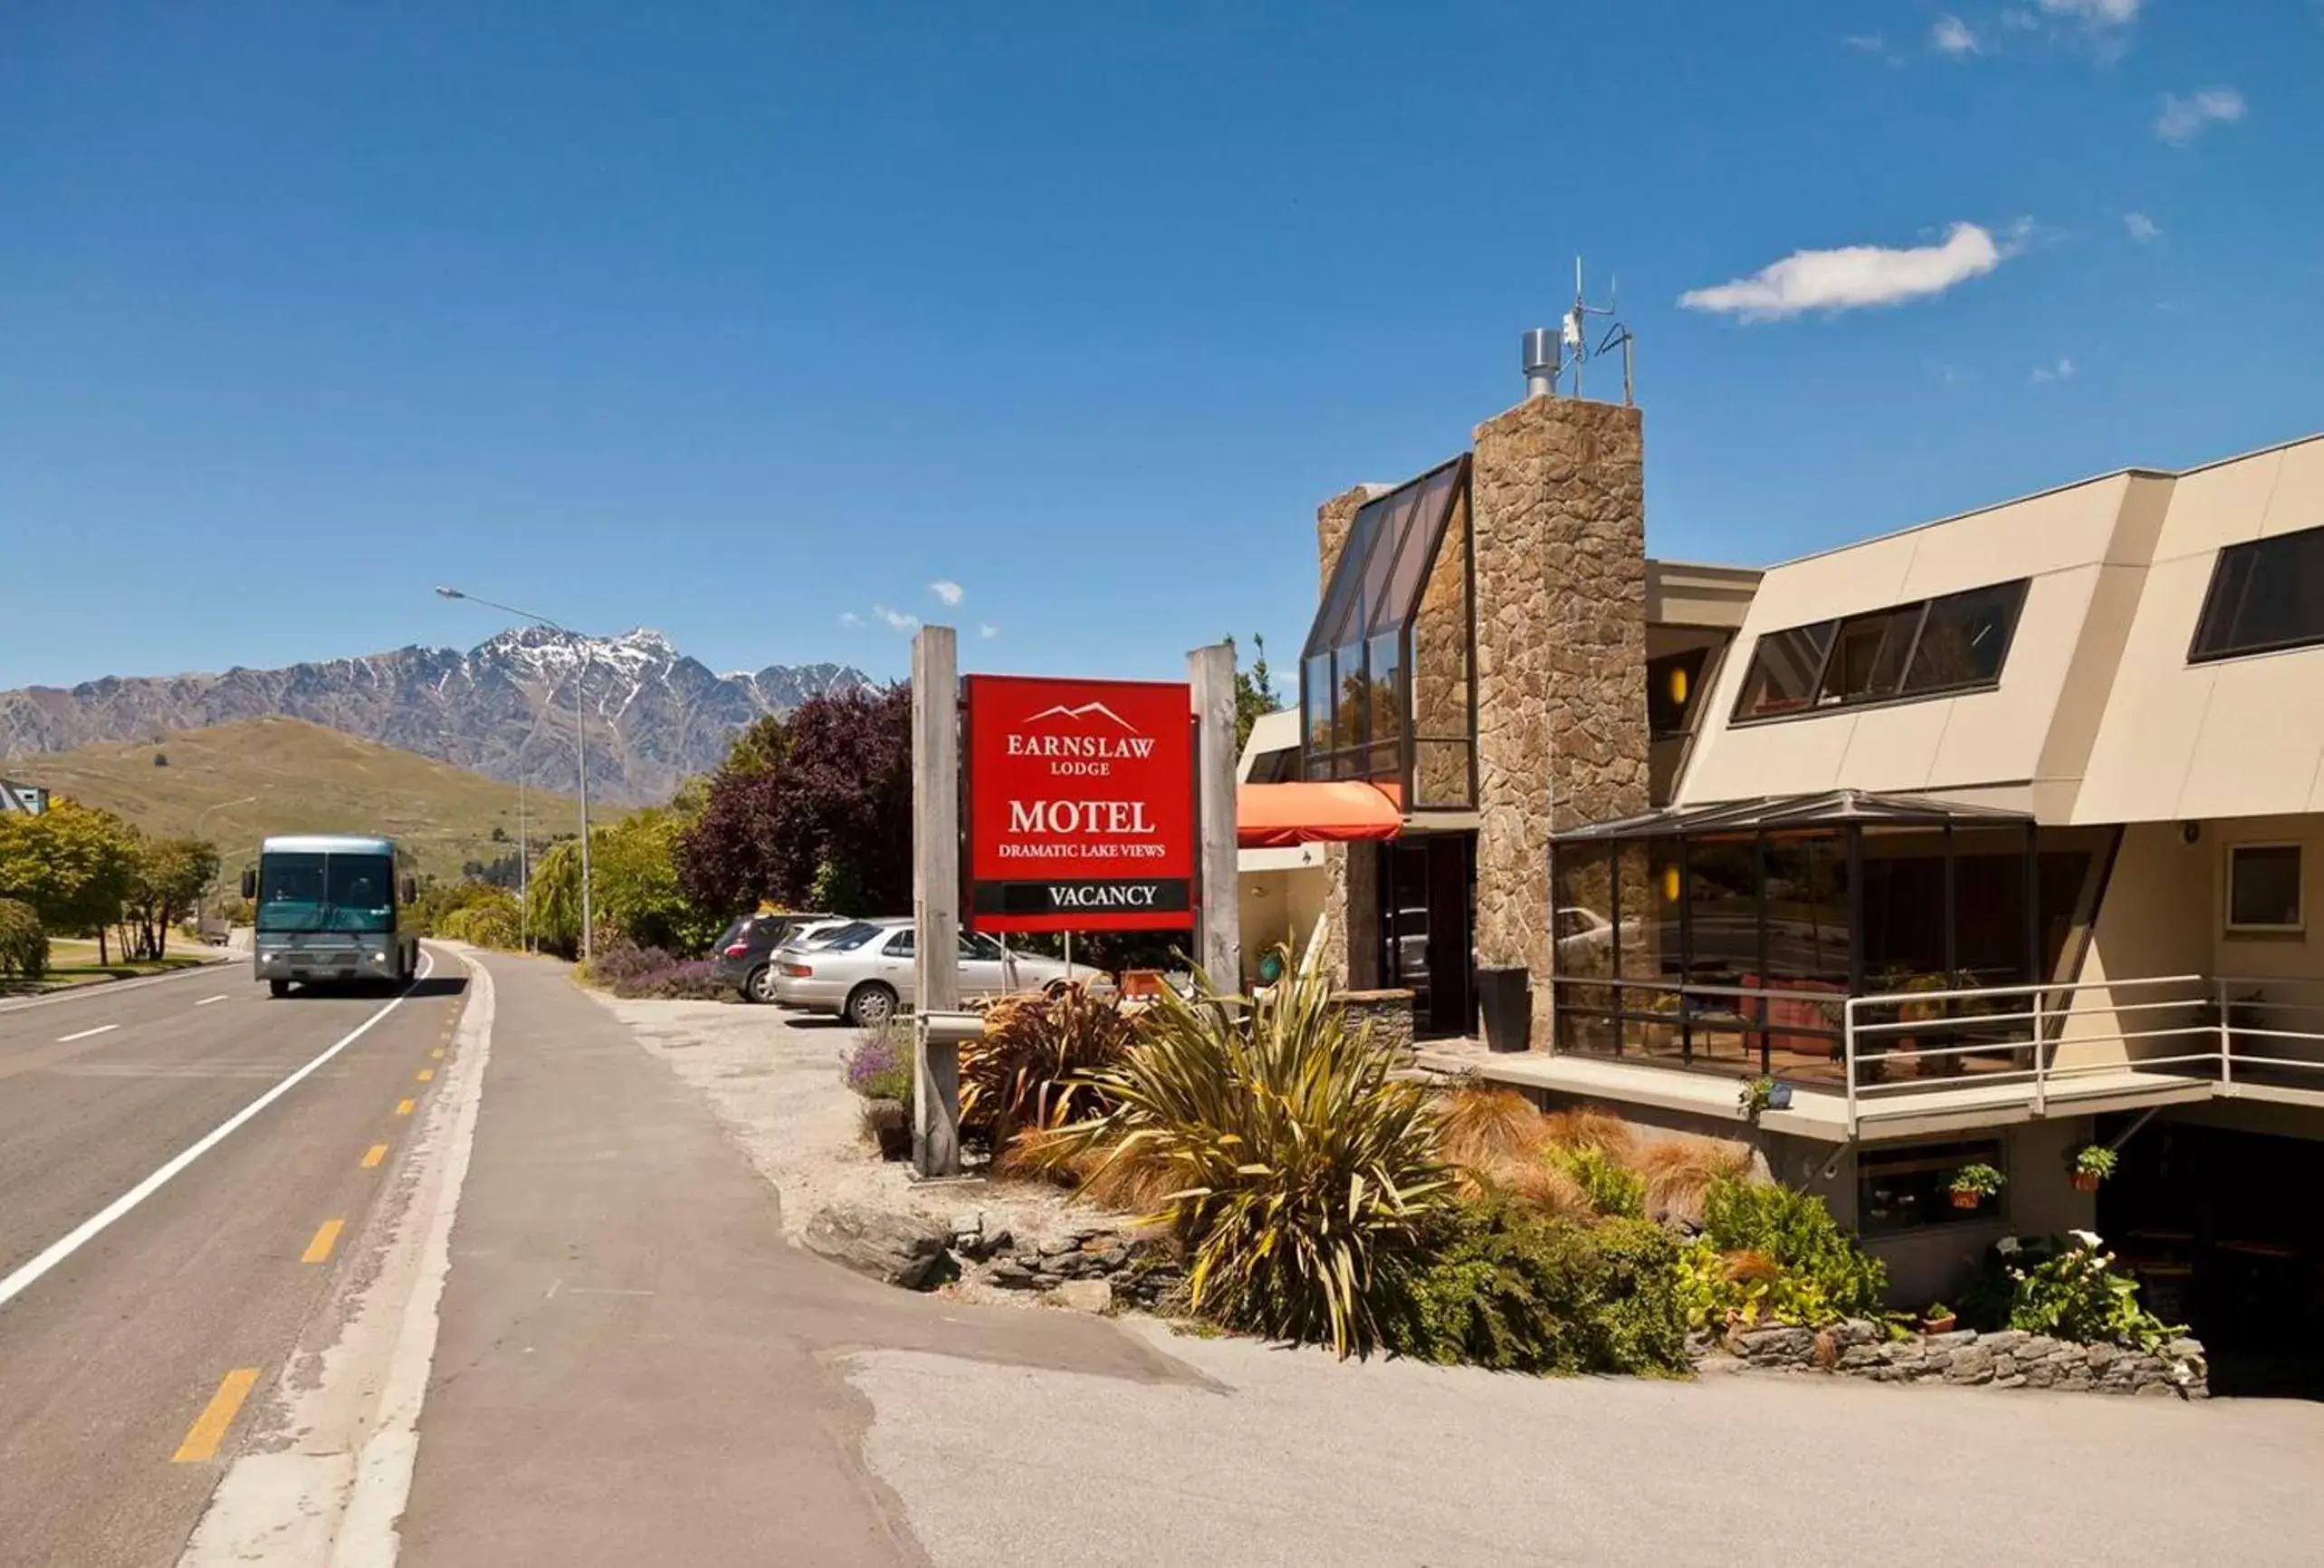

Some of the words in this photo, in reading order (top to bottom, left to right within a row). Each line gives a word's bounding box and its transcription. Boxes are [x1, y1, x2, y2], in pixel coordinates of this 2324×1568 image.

[1007, 734, 1155, 759] EARNSLAW
[1050, 761, 1110, 776] LODGE
[1008, 799, 1156, 834] MOTEL
[999, 844, 1078, 857] DRAMATIC
[1080, 845, 1118, 857] LAKE
[1120, 844, 1165, 858] VIEWS
[1047, 885, 1157, 906] VACANCY
